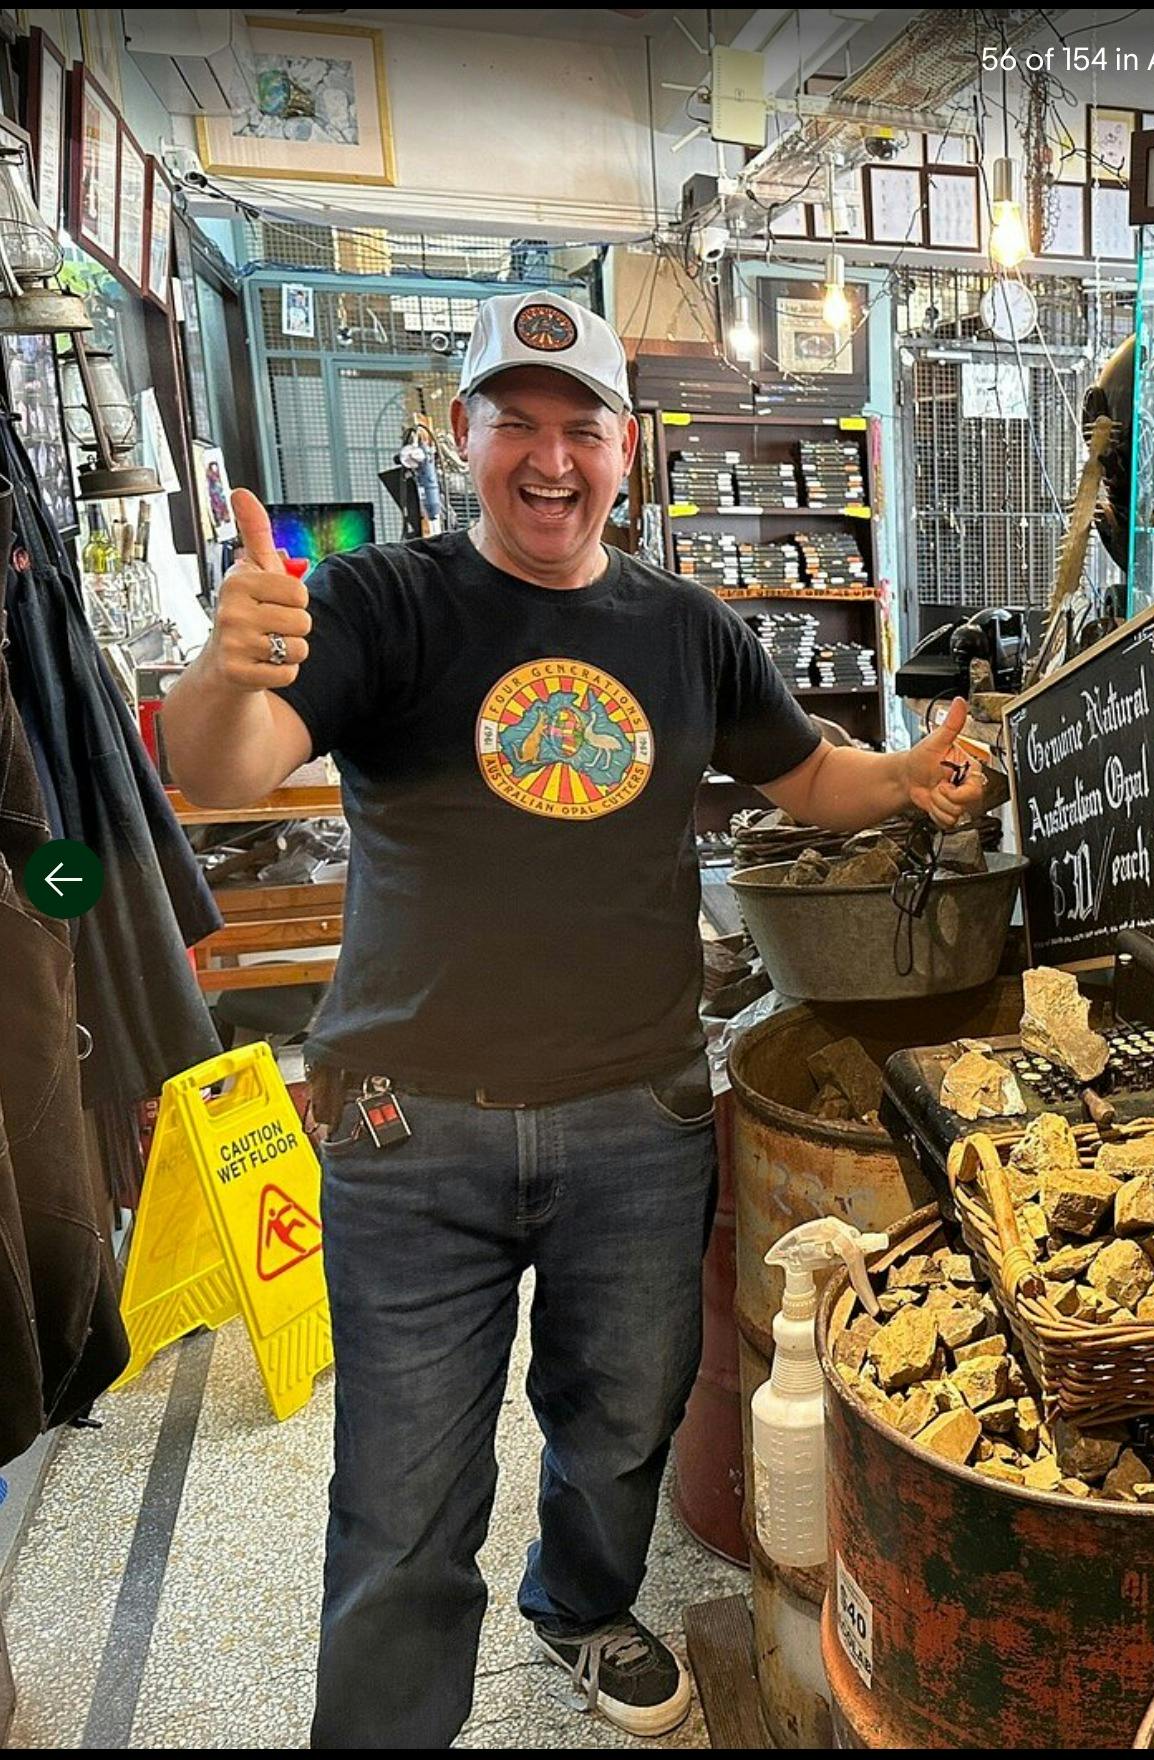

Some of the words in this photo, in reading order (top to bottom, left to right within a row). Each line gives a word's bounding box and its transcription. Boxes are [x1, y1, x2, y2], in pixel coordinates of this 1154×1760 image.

[488, 677, 523, 715] FOUR
[531, 664, 643, 726] GENERATIONS
[1027, 715, 1083, 775] Genuine
[1082, 665, 1150, 744] Natural
[485, 758, 554, 814] AUSTRALIAN
[561, 804, 598, 816] OPAL
[601, 767, 645, 809] CUTTERS
[1028, 775, 1104, 843] Australian
[1104, 743, 1150, 818] Opal
[216, 1156, 248, 1184] WET
[249, 1133, 299, 1168] FLOOR
[220, 1119, 284, 1162] CAUTION
